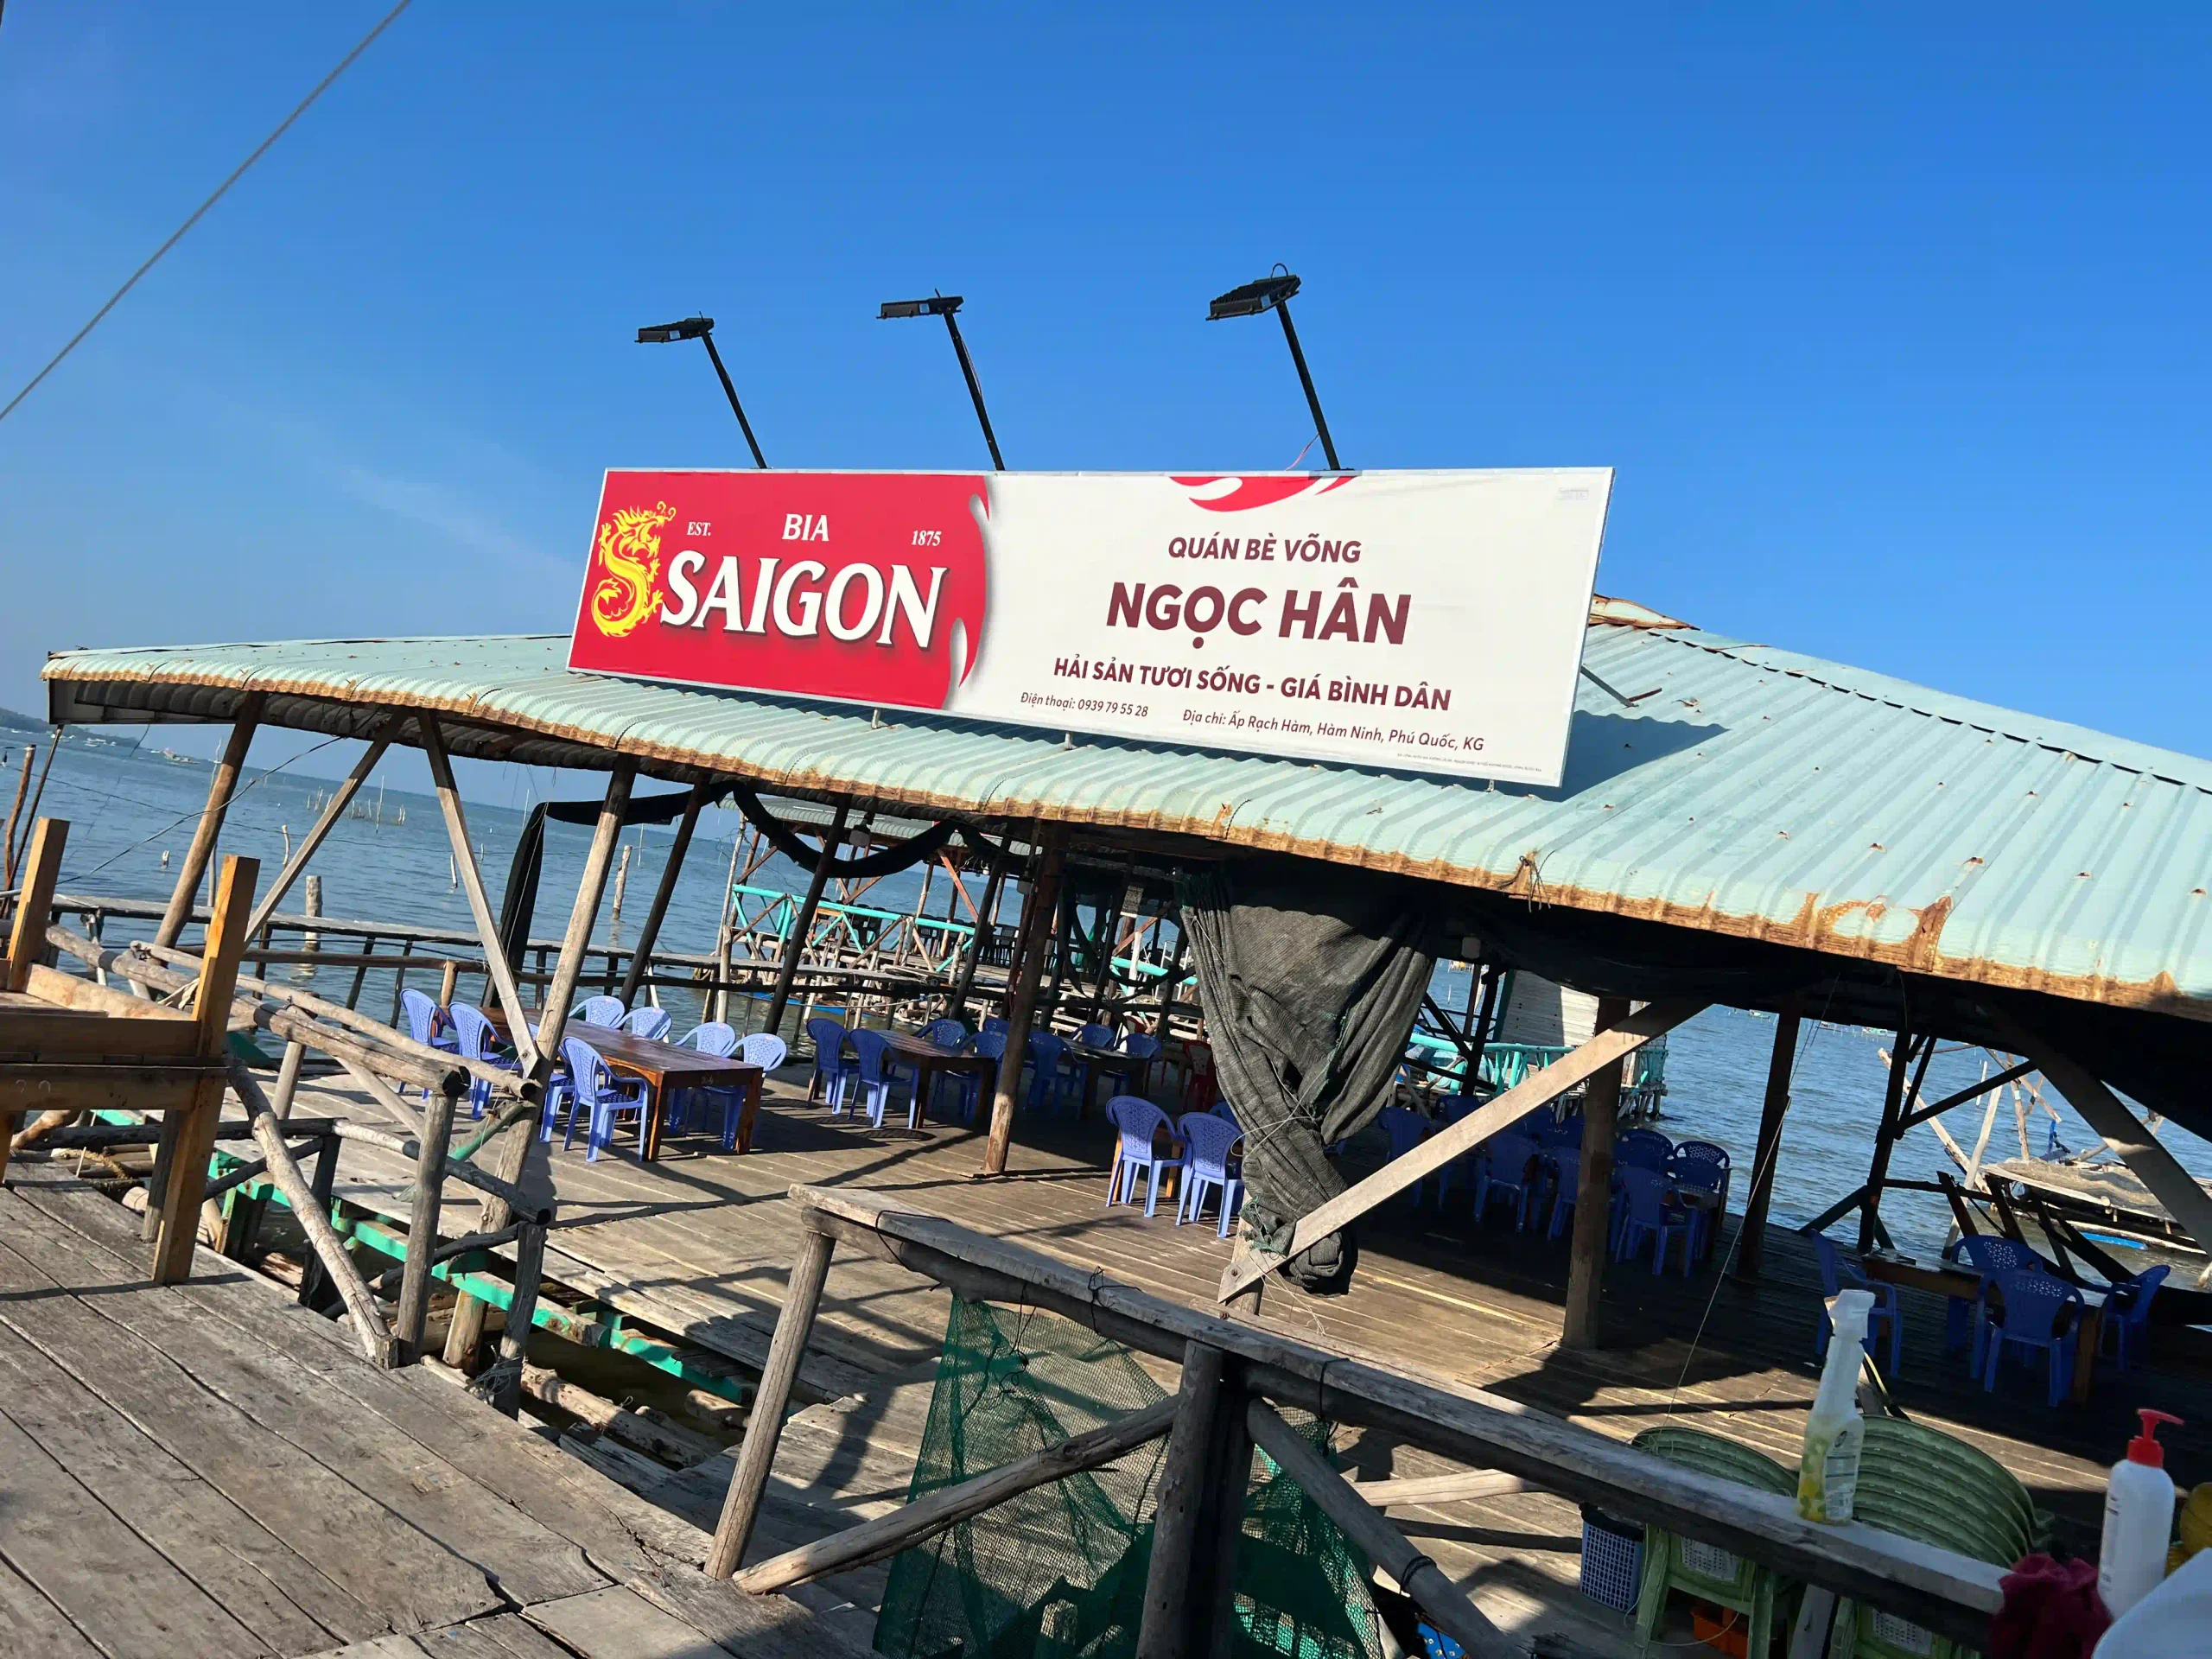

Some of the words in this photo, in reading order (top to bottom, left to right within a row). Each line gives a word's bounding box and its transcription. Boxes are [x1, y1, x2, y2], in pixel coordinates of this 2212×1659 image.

[686, 521, 712, 537] EST.
[782, 513, 830, 542] BIA
[911, 530, 942, 546] 1875
[1168, 531, 1240, 560] QUÁN
[1244, 532, 1276, 561] BÈ
[1284, 533, 1362, 563] VÕNG
[660, 550, 950, 650] SAIGON
[1106, 582, 1268, 650] NGỌC
[1278, 576, 1412, 645] HÂN
[1053, 653, 1089, 679] HẢI
[1092, 657, 1134, 683] SẢN
[1140, 664, 1192, 689] TƯƠI
[1196, 665, 1261, 694] SỐNG
[1281, 673, 1321, 701] GIÁ
[1327, 676, 1389, 705] BÌNH
[1394, 681, 1452, 711] DÂN
[1020, 692, 1043, 708] Điện
[1046, 695, 1075, 711] thoại:
[1077, 699, 1103, 712] 0939
[1105, 702, 1118, 714] 79
[1120, 702, 1133, 715] 55
[1135, 705, 1148, 717] 28
[1183, 709, 1203, 726] Địa
[1228, 710, 1245, 729] Ấp
[1248, 715, 1278, 733] Rạch
[1281, 719, 1313, 735] Hàm,
[1317, 722, 1347, 737] Hàm
[1350, 726, 1384, 743] Ninh,
[1389, 729, 1414, 744] Phú
[1418, 733, 1459, 751] Quốc,
[1463, 736, 1484, 751] KG
